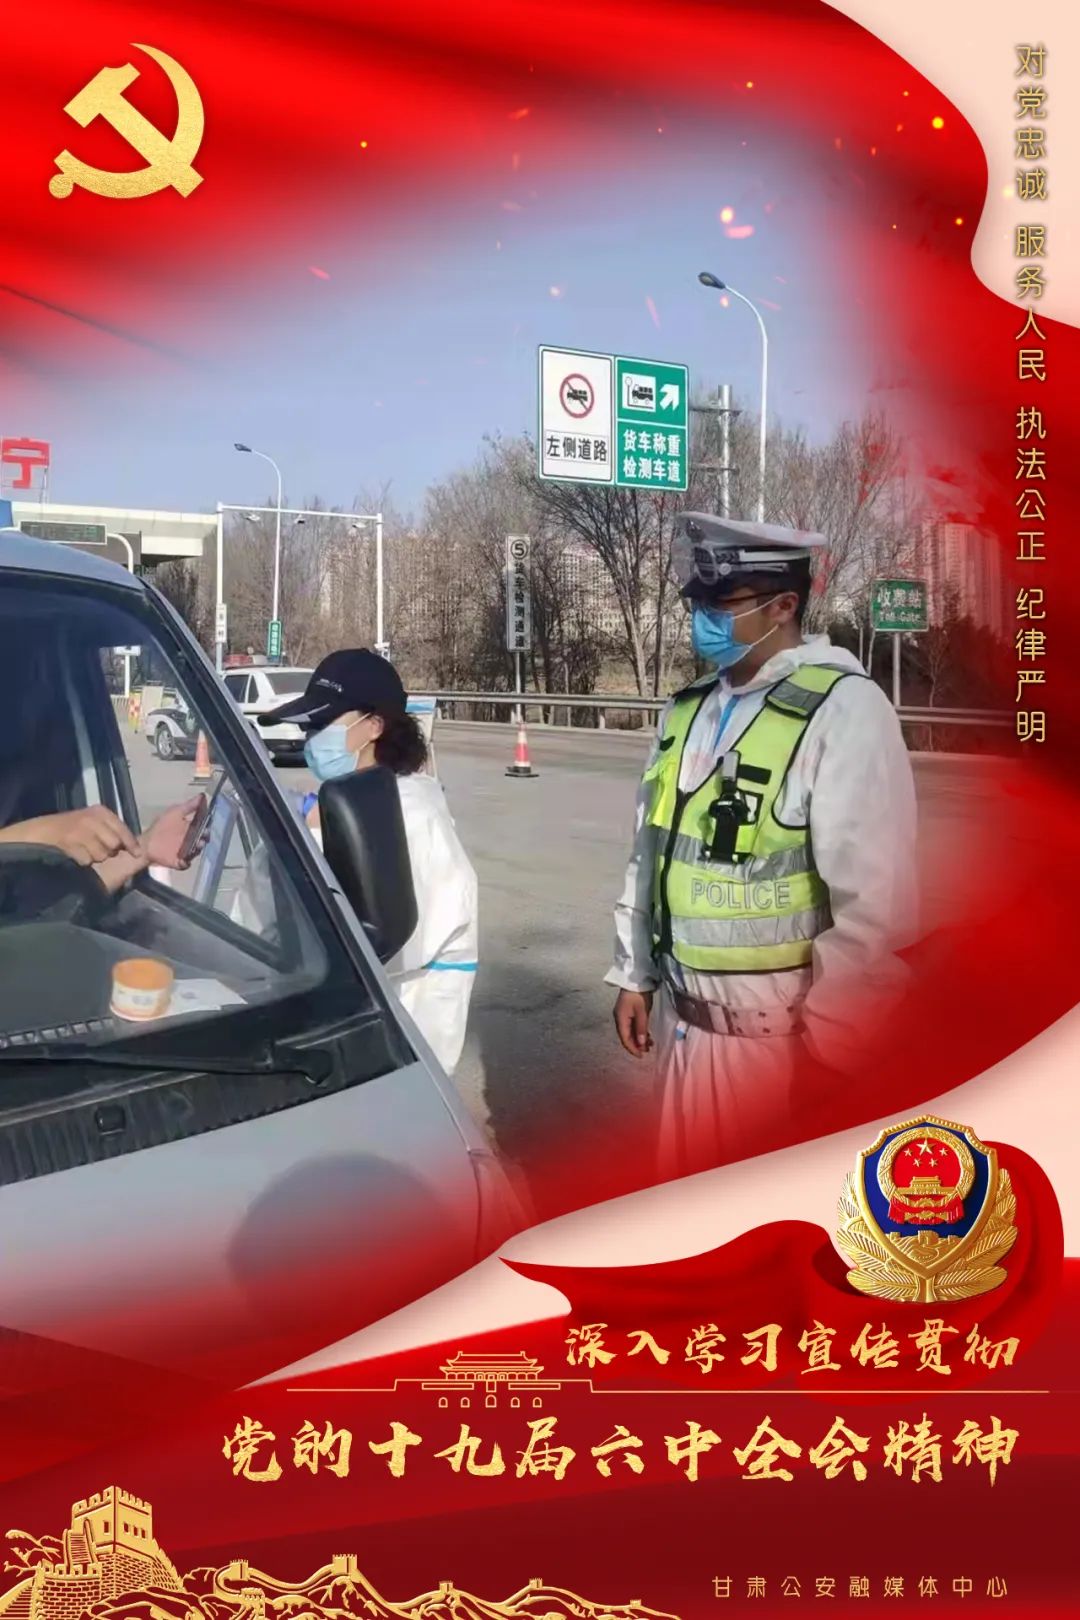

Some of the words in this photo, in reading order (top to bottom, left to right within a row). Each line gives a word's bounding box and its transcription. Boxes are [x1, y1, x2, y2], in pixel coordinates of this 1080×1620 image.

[546, 435, 607, 462] 左侧道路
[623, 429, 681, 457] 货车称重
[1, 437, 50, 489] 宁
[623, 455, 681, 482] 检测车道
[690, 878, 791, 909] POLICE
